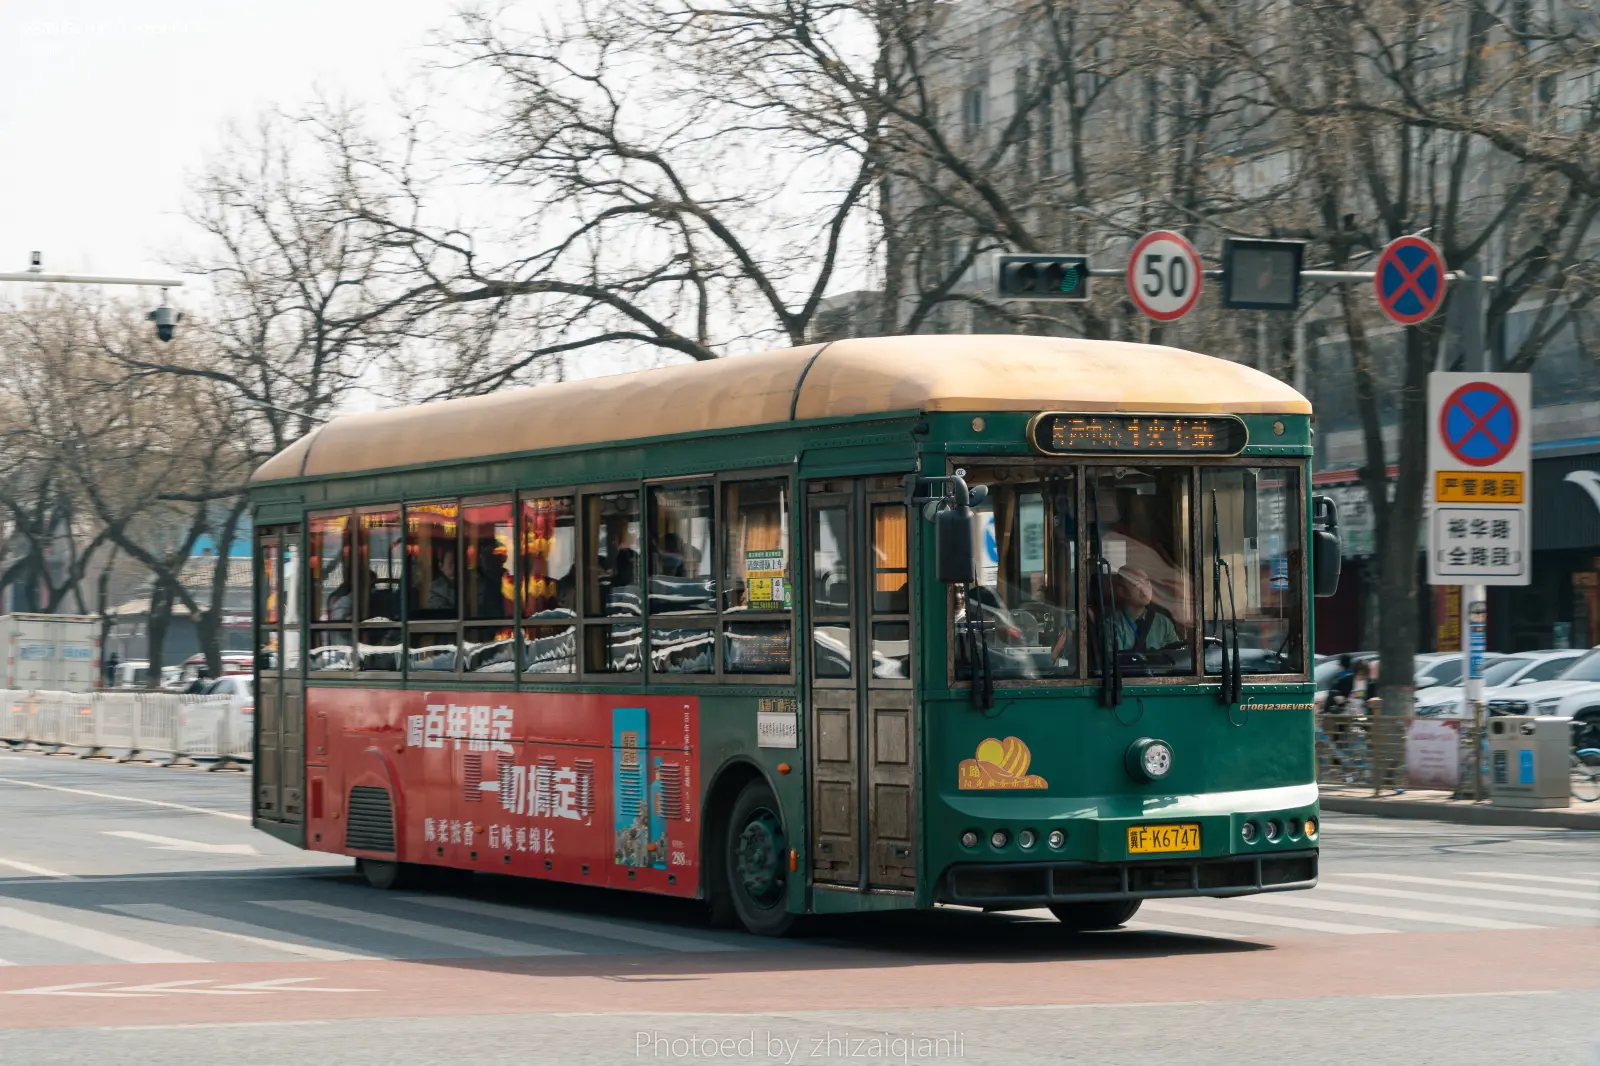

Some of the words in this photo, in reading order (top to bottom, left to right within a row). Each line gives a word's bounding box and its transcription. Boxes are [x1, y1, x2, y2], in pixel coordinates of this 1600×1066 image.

[1142, 253, 1188, 298] 50
[1441, 478, 1518, 496] 严管路段
